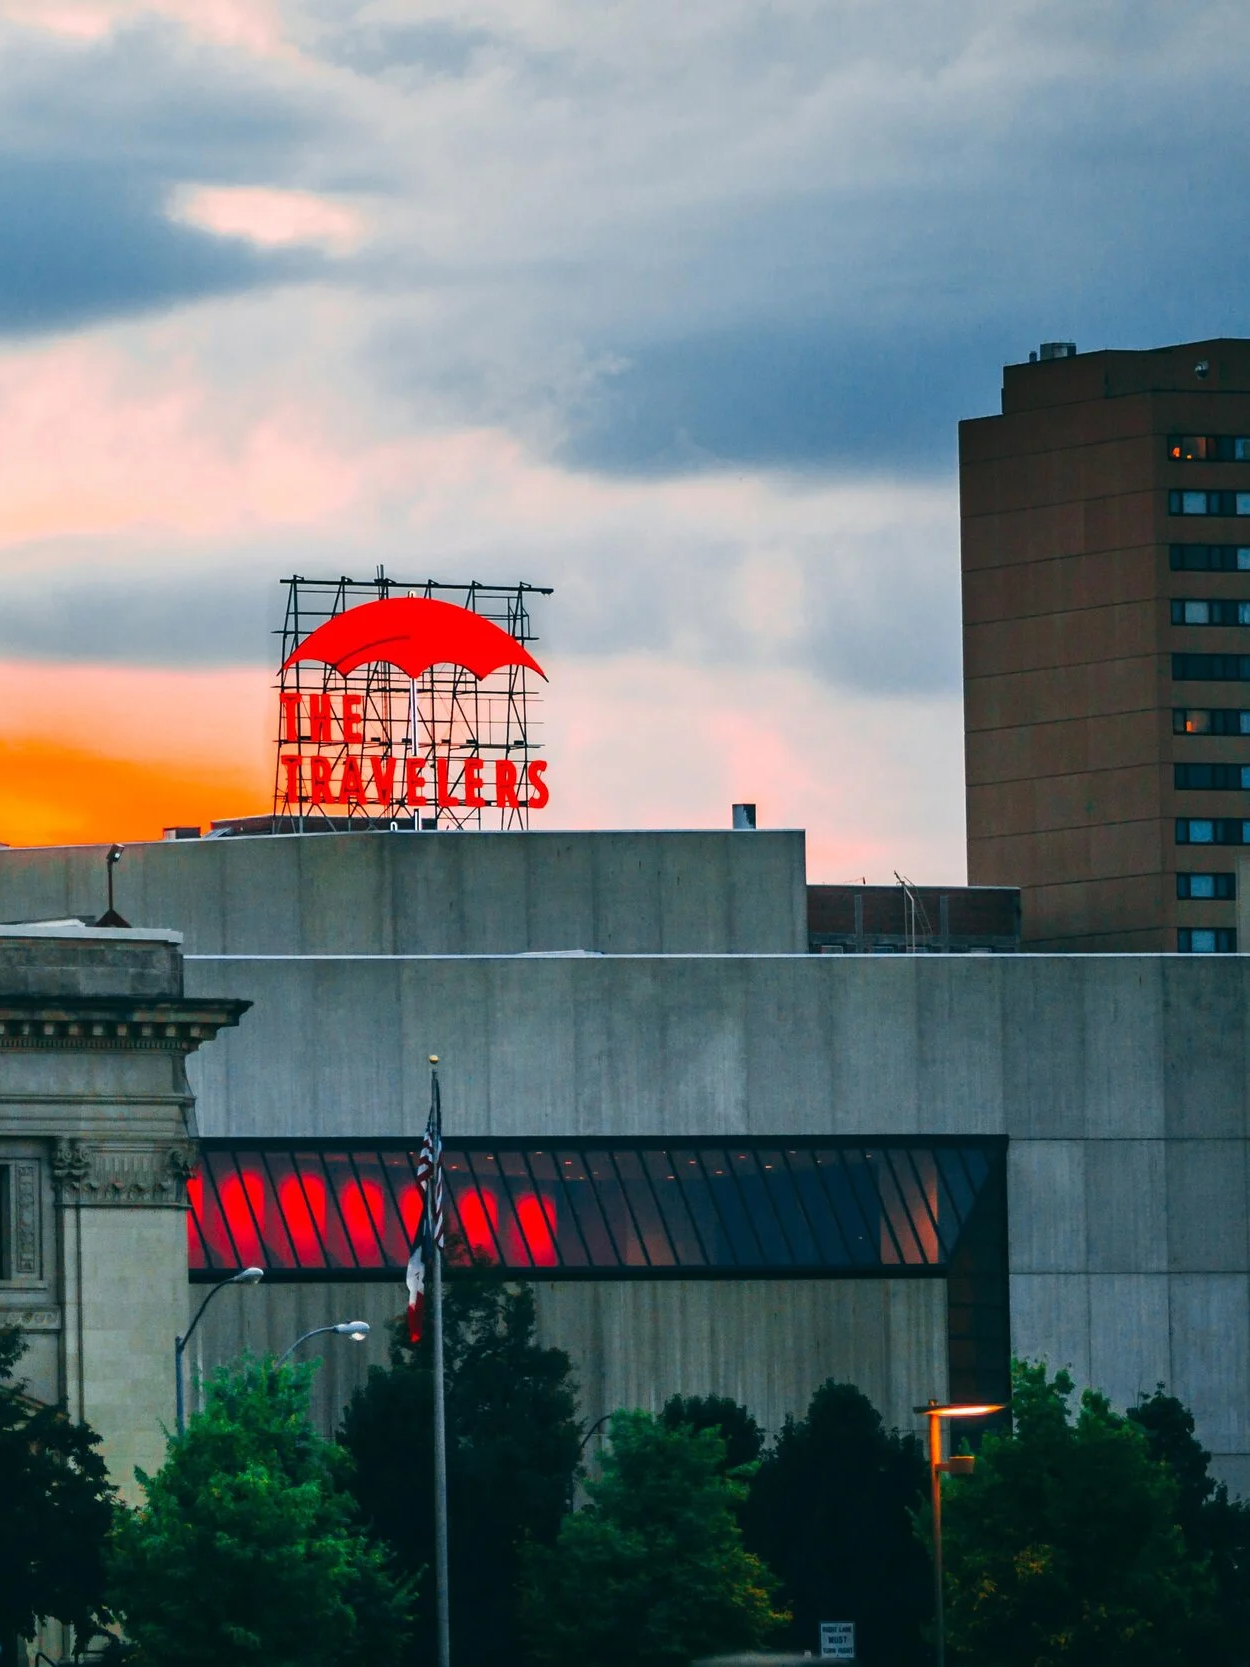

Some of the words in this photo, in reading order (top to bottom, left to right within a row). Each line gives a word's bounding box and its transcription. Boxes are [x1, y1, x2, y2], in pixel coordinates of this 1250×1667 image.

[280, 692, 364, 744] THE
[280, 754, 549, 809] TRAVELERS
[828, 1636, 846, 1644] MUST
